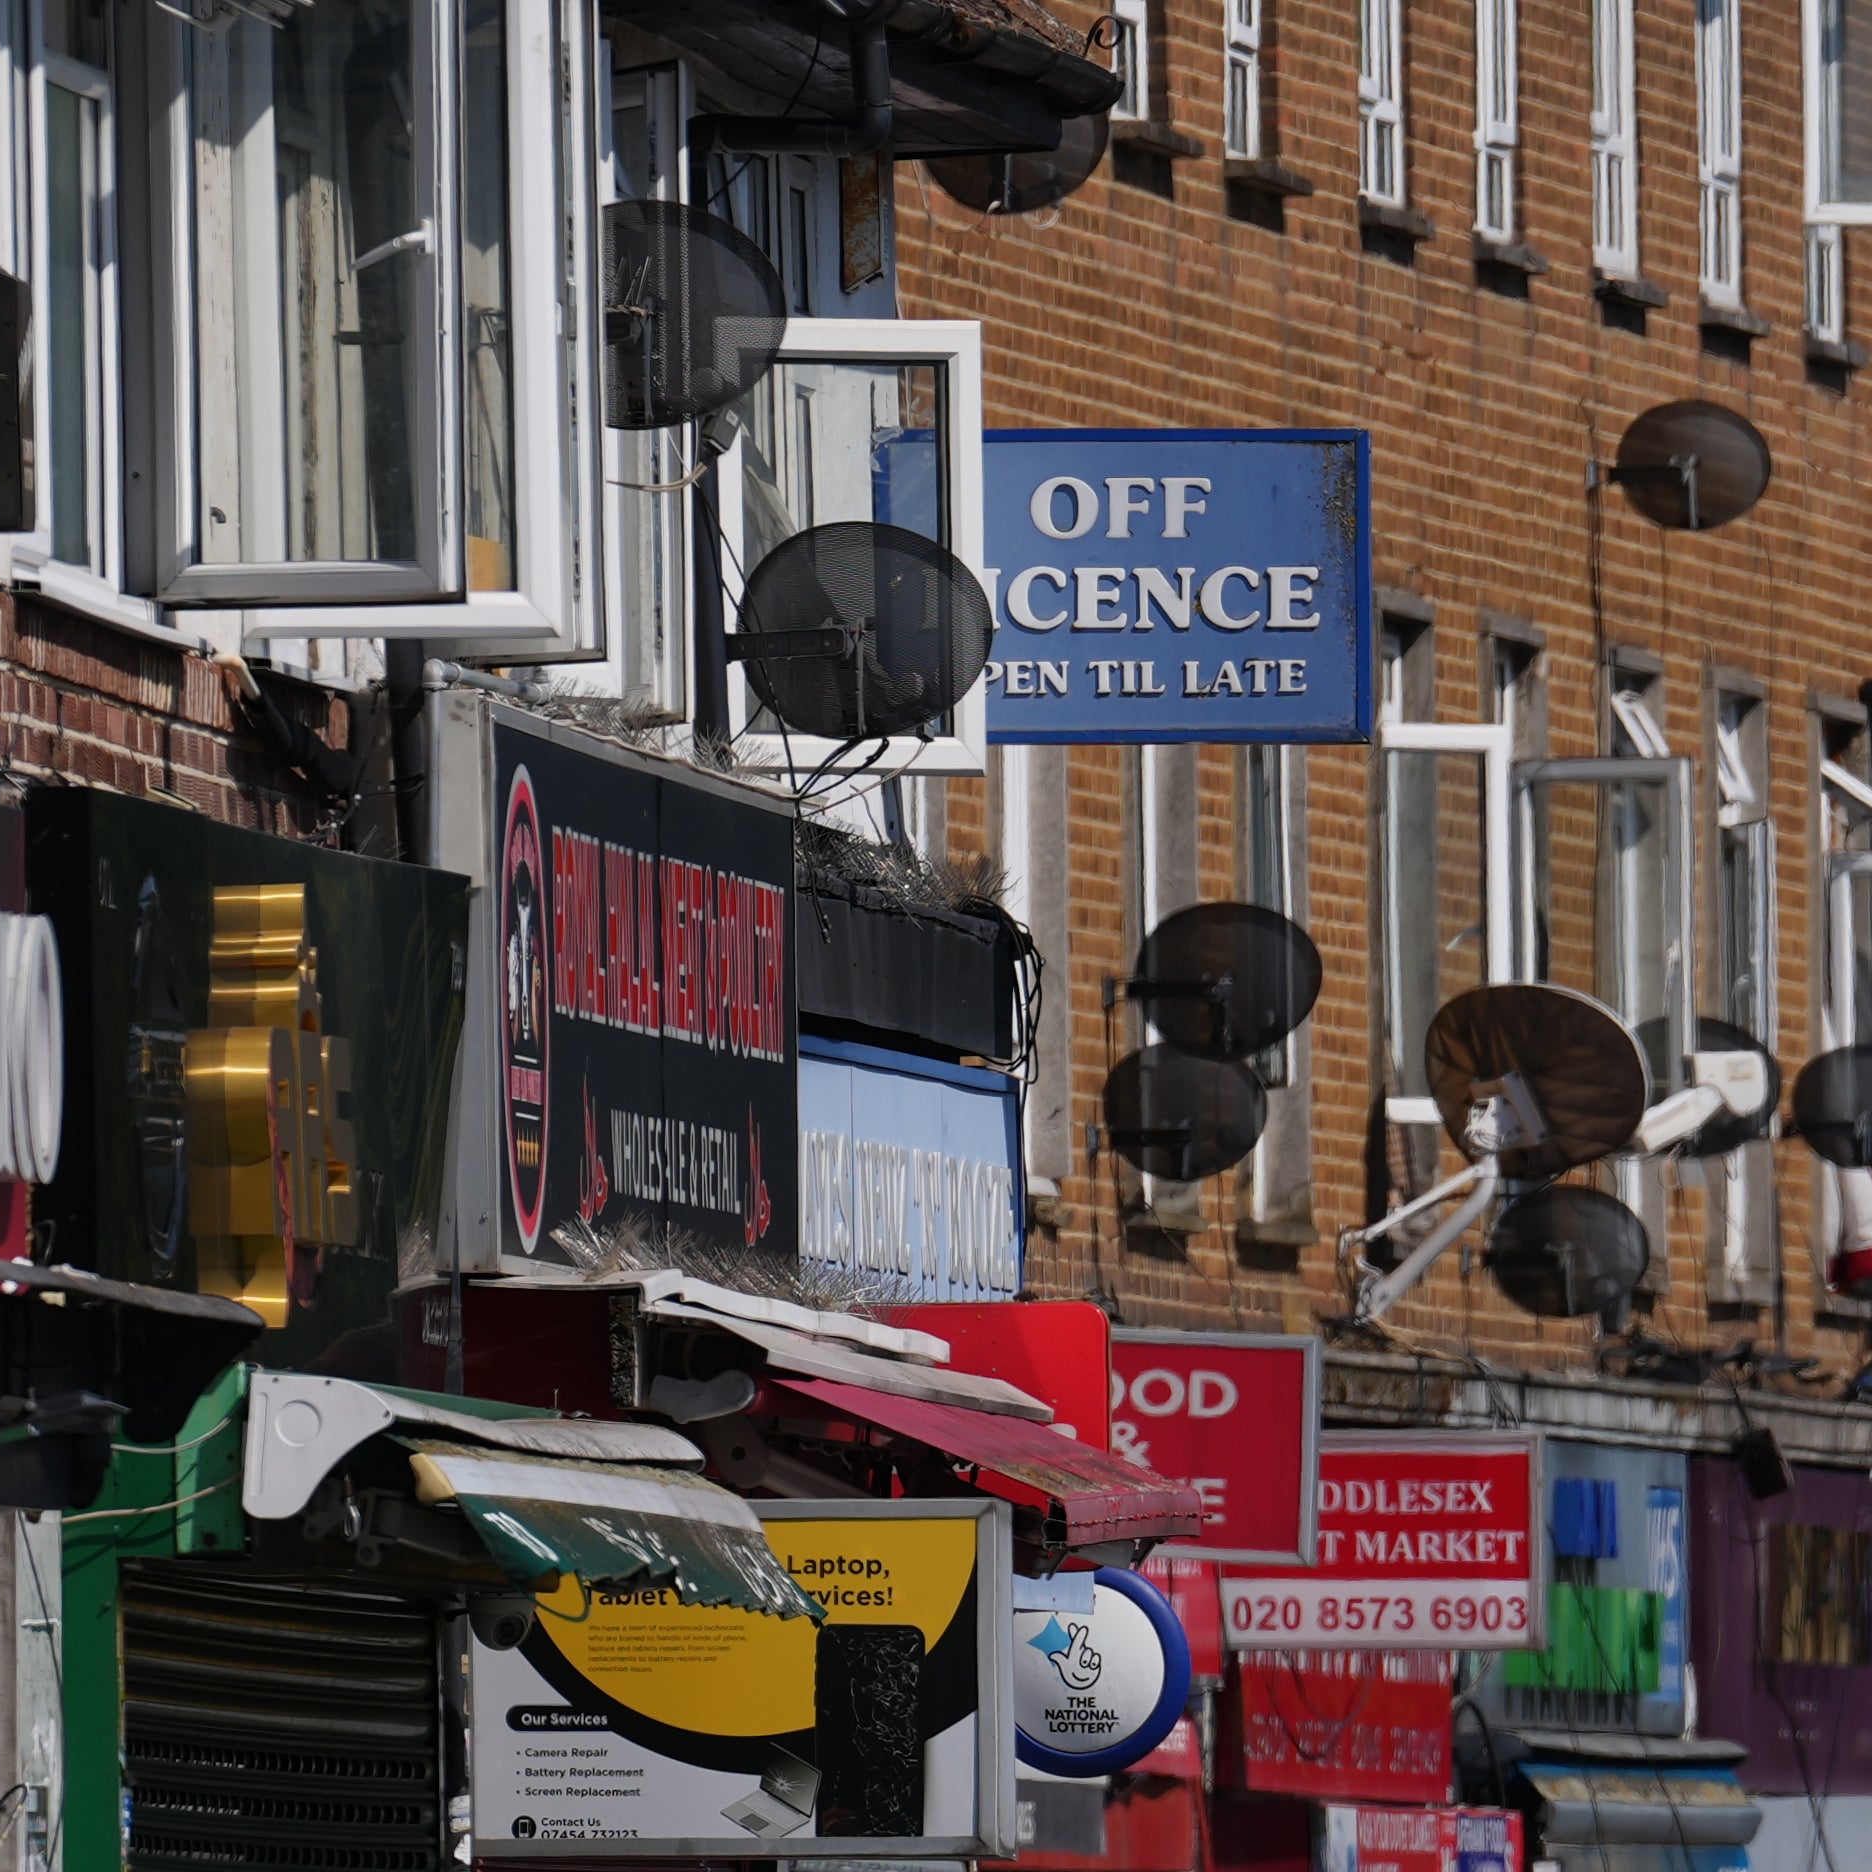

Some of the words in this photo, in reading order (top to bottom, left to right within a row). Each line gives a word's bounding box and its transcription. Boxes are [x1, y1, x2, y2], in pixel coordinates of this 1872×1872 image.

[1030, 475, 1211, 540] OFF
[985, 565, 1320, 632] ICENCE
[986, 660, 1069, 697] PEN
[1084, 660, 1165, 696] TIL
[1184, 658, 1308, 694] LATE
[552, 825, 606, 1025] ROYAL
[605, 841, 660, 1038] HALAL
[660, 855, 702, 1044] MEAT
[705, 865, 717, 1056] &
[718, 871, 784, 1064] POULTRY
[611, 1108, 685, 1204] WHOLESALE
[690, 1128, 698, 1206] &
[702, 1126, 741, 1215] RETAIL
[946, 1157, 1016, 1291] BOOZE
[1112, 1369, 1238, 1417] OD
[1318, 1480, 1493, 1514] DDLESEX
[1355, 1530, 1524, 1564] MARKET
[787, 1555, 890, 1579] Laptop,
[809, 1586, 893, 1605] rvices!
[1233, 1596, 1302, 1631] 020
[1318, 1596, 1414, 1631] 8573
[1430, 1596, 1527, 1631] 6903
[1066, 1696, 1097, 1709] THE
[521, 1713, 547, 1726] Our
[550, 1712, 608, 1726] Services
[1044, 1709, 1119, 1723] NATIONAL
[1048, 1721, 1117, 1734] LOTTERY
[525, 1748, 567, 1757] Camera
[571, 1748, 608, 1759] Repair
[525, 1768, 565, 1778] Battery
[569, 1768, 644, 1778] Replacement
[525, 1788, 562, 1796] Screen
[566, 1788, 641, 1798] Replacement
[541, 1818, 584, 1826] Contact
[588, 1818, 601, 1826] Us
[541, 1830, 585, 1838] 07454
